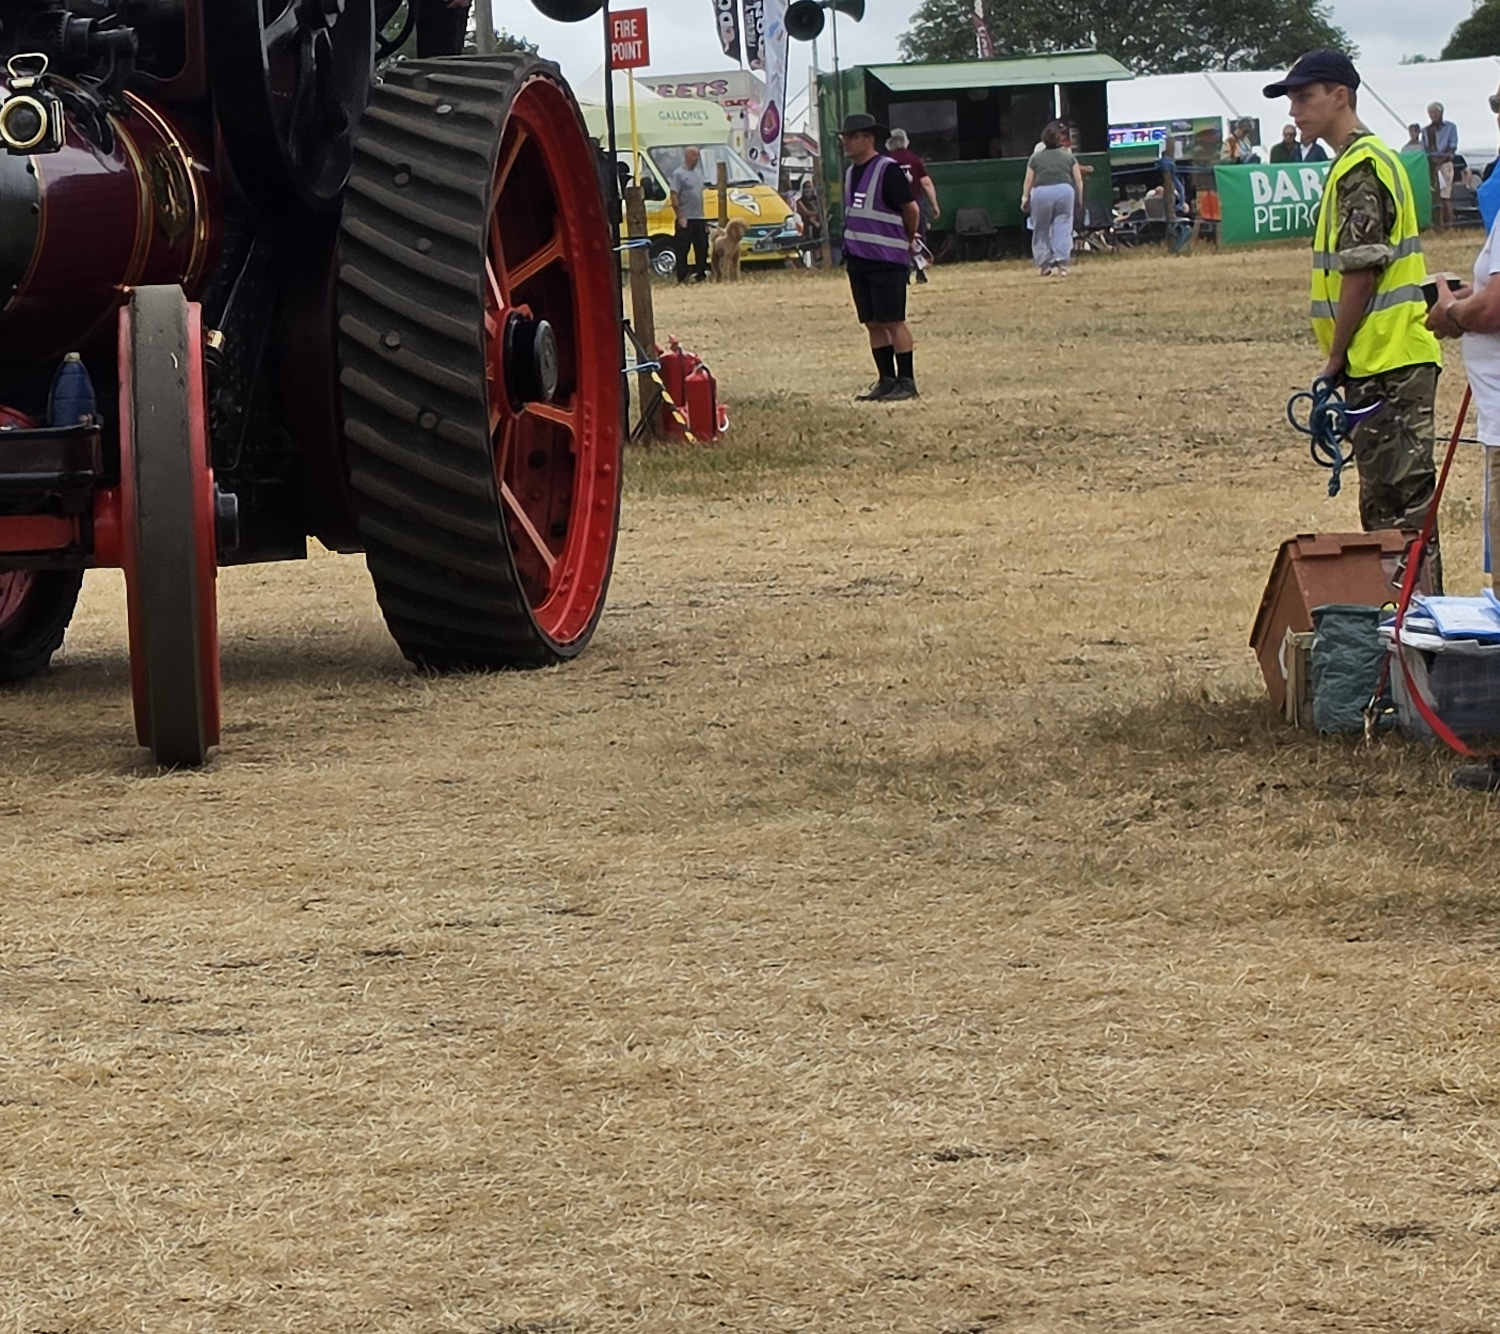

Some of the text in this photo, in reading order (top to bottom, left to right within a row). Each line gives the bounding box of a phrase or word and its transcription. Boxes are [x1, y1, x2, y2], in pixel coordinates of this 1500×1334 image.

[614, 18, 638, 39] FIRE
[611, 40, 643, 61] POINT
[647, 79, 729, 99] EETS
